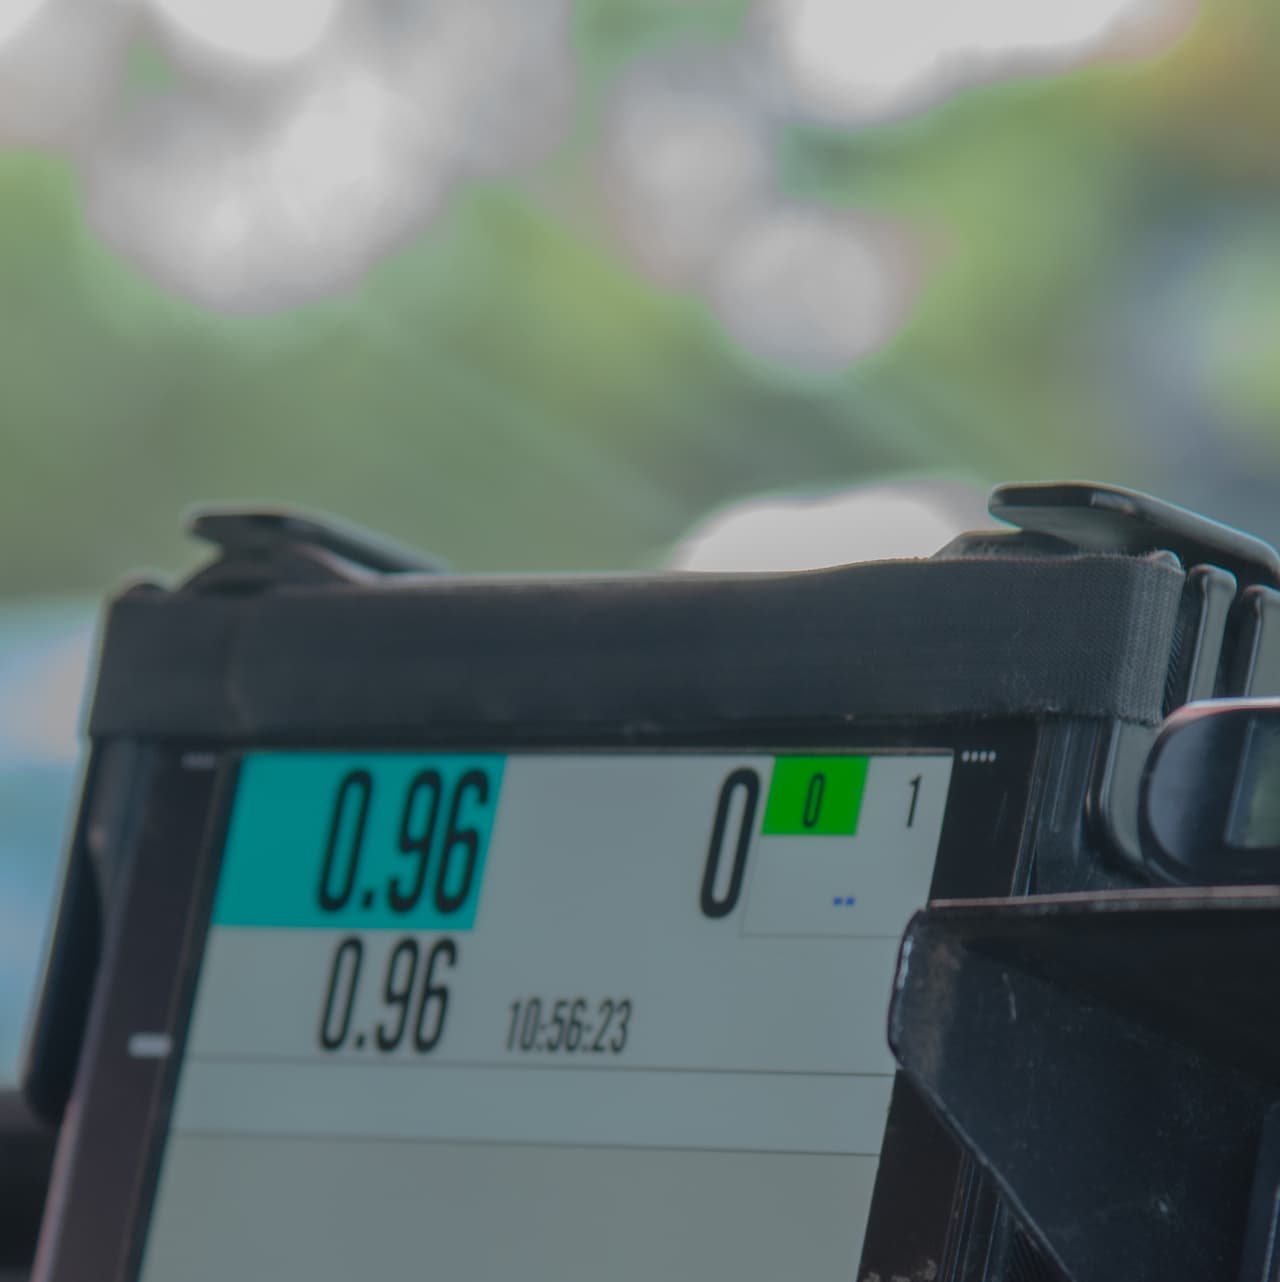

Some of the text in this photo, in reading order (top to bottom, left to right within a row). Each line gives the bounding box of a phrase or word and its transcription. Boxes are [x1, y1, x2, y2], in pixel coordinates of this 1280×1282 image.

[316, 768, 491, 914] 0.96
[699, 766, 761, 920] 0
[802, 771, 826, 829] 0
[905, 774, 923, 829] 1
[318, 937, 459, 1054] 0.96
[505, 996, 633, 1055] 10:56:23
